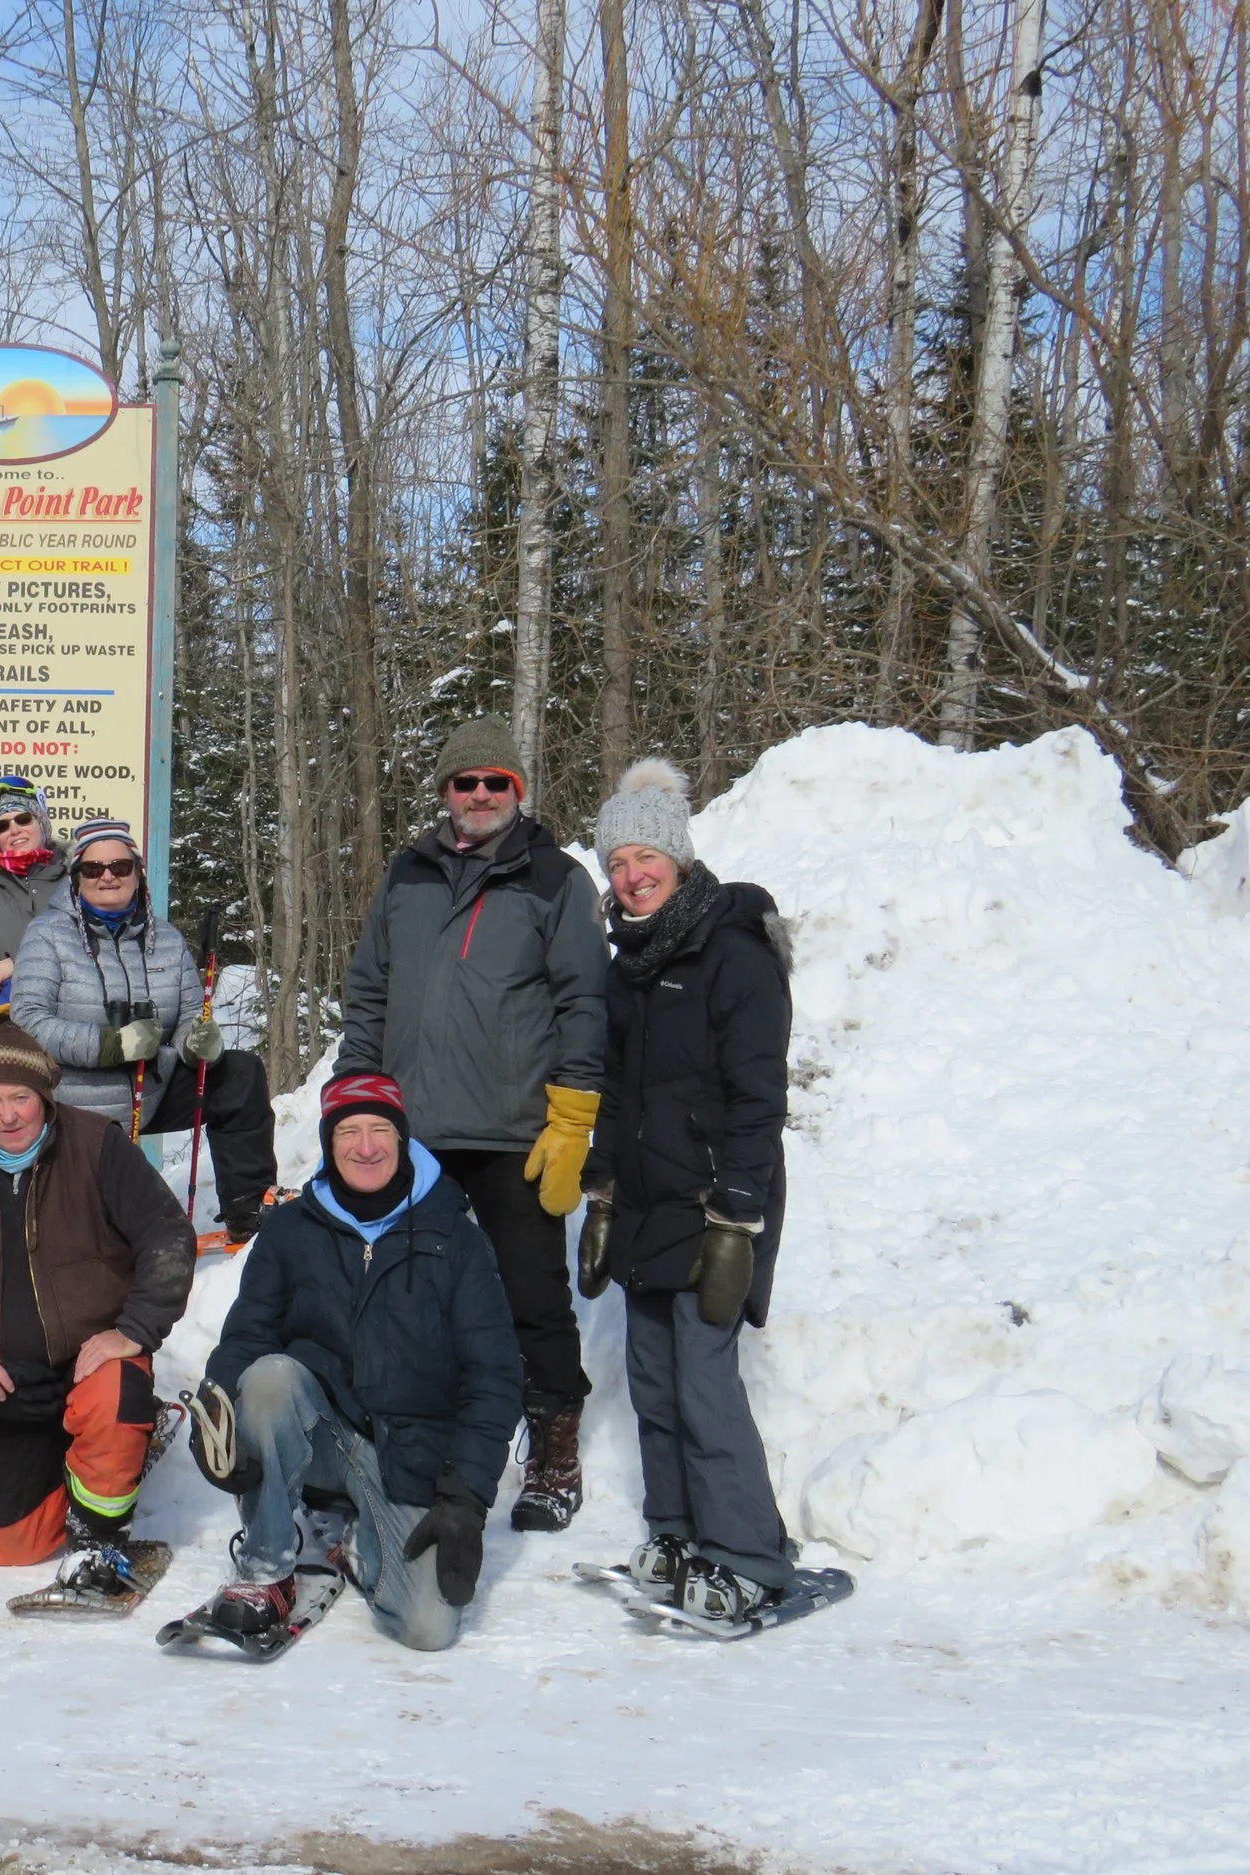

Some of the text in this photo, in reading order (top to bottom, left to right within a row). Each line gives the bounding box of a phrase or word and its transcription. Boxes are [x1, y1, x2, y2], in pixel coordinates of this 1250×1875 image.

[3, 486, 74, 515] Point
[79, 486, 143, 516] Park
[39, 534, 77, 548] YEAR
[81, 534, 137, 549] ROUND
[28, 560, 66, 571] OUR
[72, 561, 118, 572] TRAIL
[7, 582, 112, 602] PICTURES,
[38, 603, 136, 615] FOOTPRINTS
[21, 644, 55, 655] PICK
[61, 645, 80, 656] UP
[85, 645, 135, 656] WASTE
[63, 700, 103, 713] AND
[26, 720, 50, 733] OF
[56, 721, 96, 737] ALL,
[0, 742, 27, 755] DO
[32, 742, 79, 756] NOT:
[74, 764, 136, 782] WOOD,
